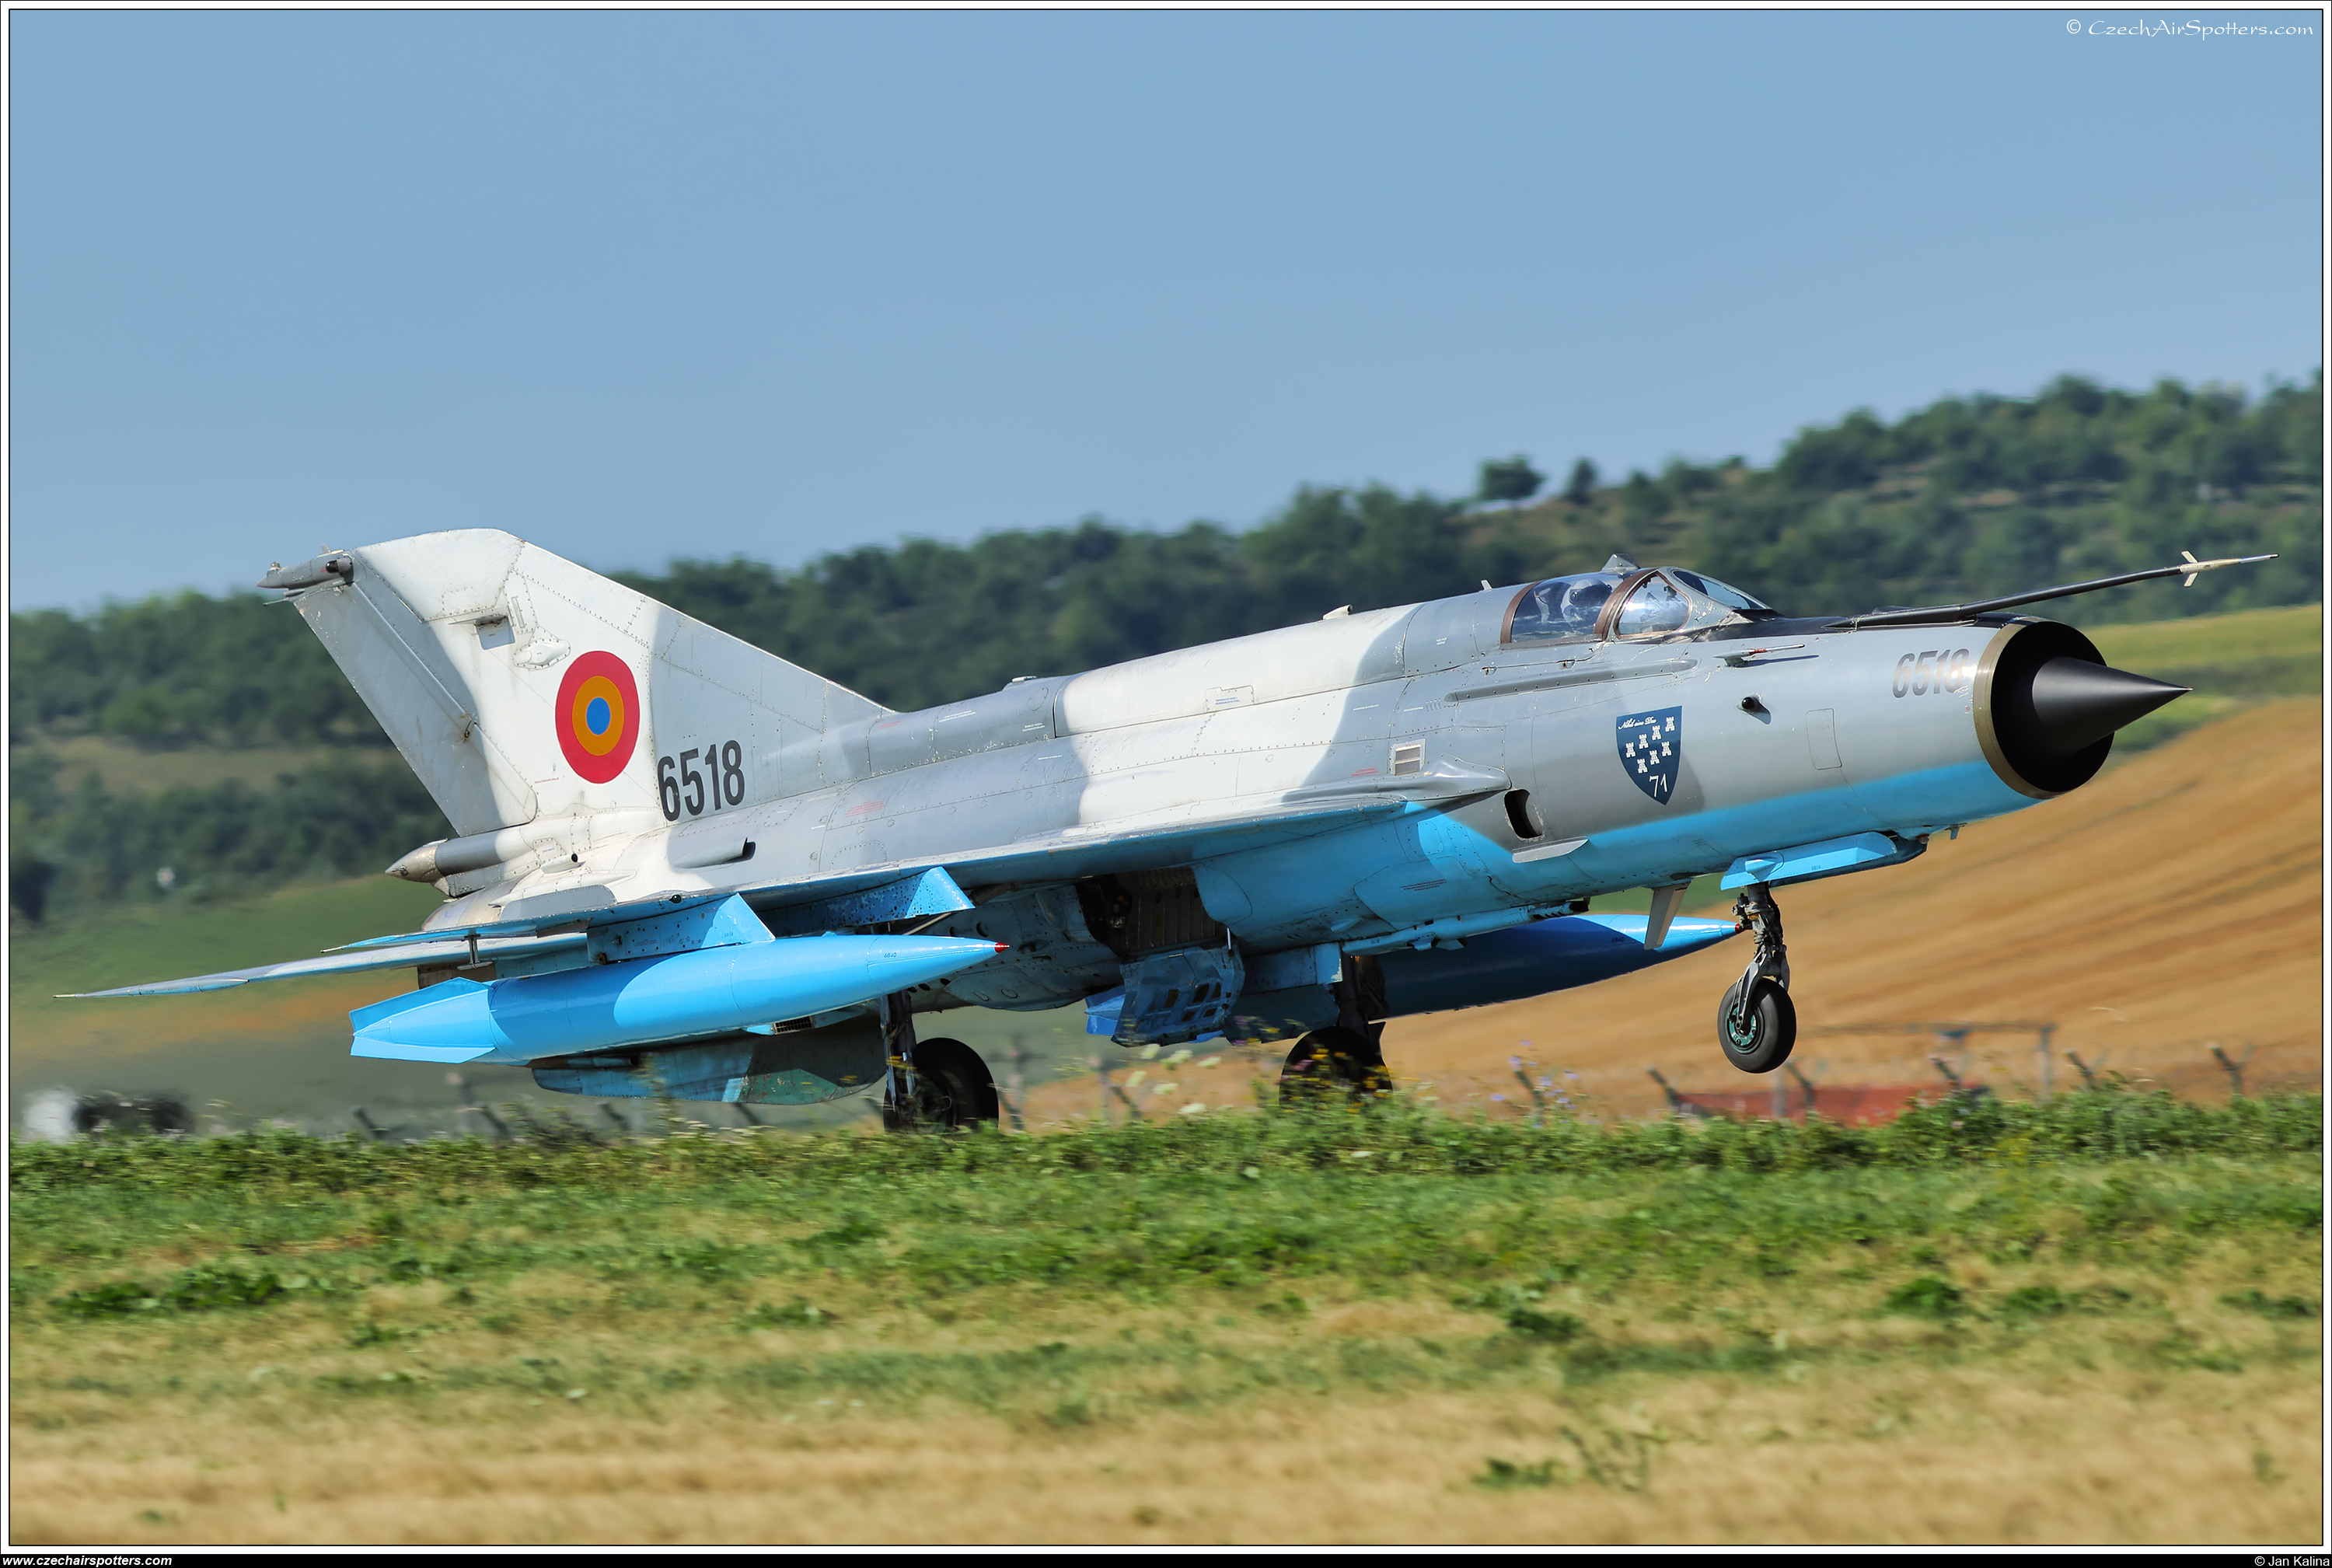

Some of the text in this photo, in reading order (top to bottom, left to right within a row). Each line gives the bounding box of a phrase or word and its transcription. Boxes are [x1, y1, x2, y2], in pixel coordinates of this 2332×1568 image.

[1892, 648, 1970, 699] 6518
[657, 739, 745, 822] 6518
[1649, 773, 1668, 798] 71
